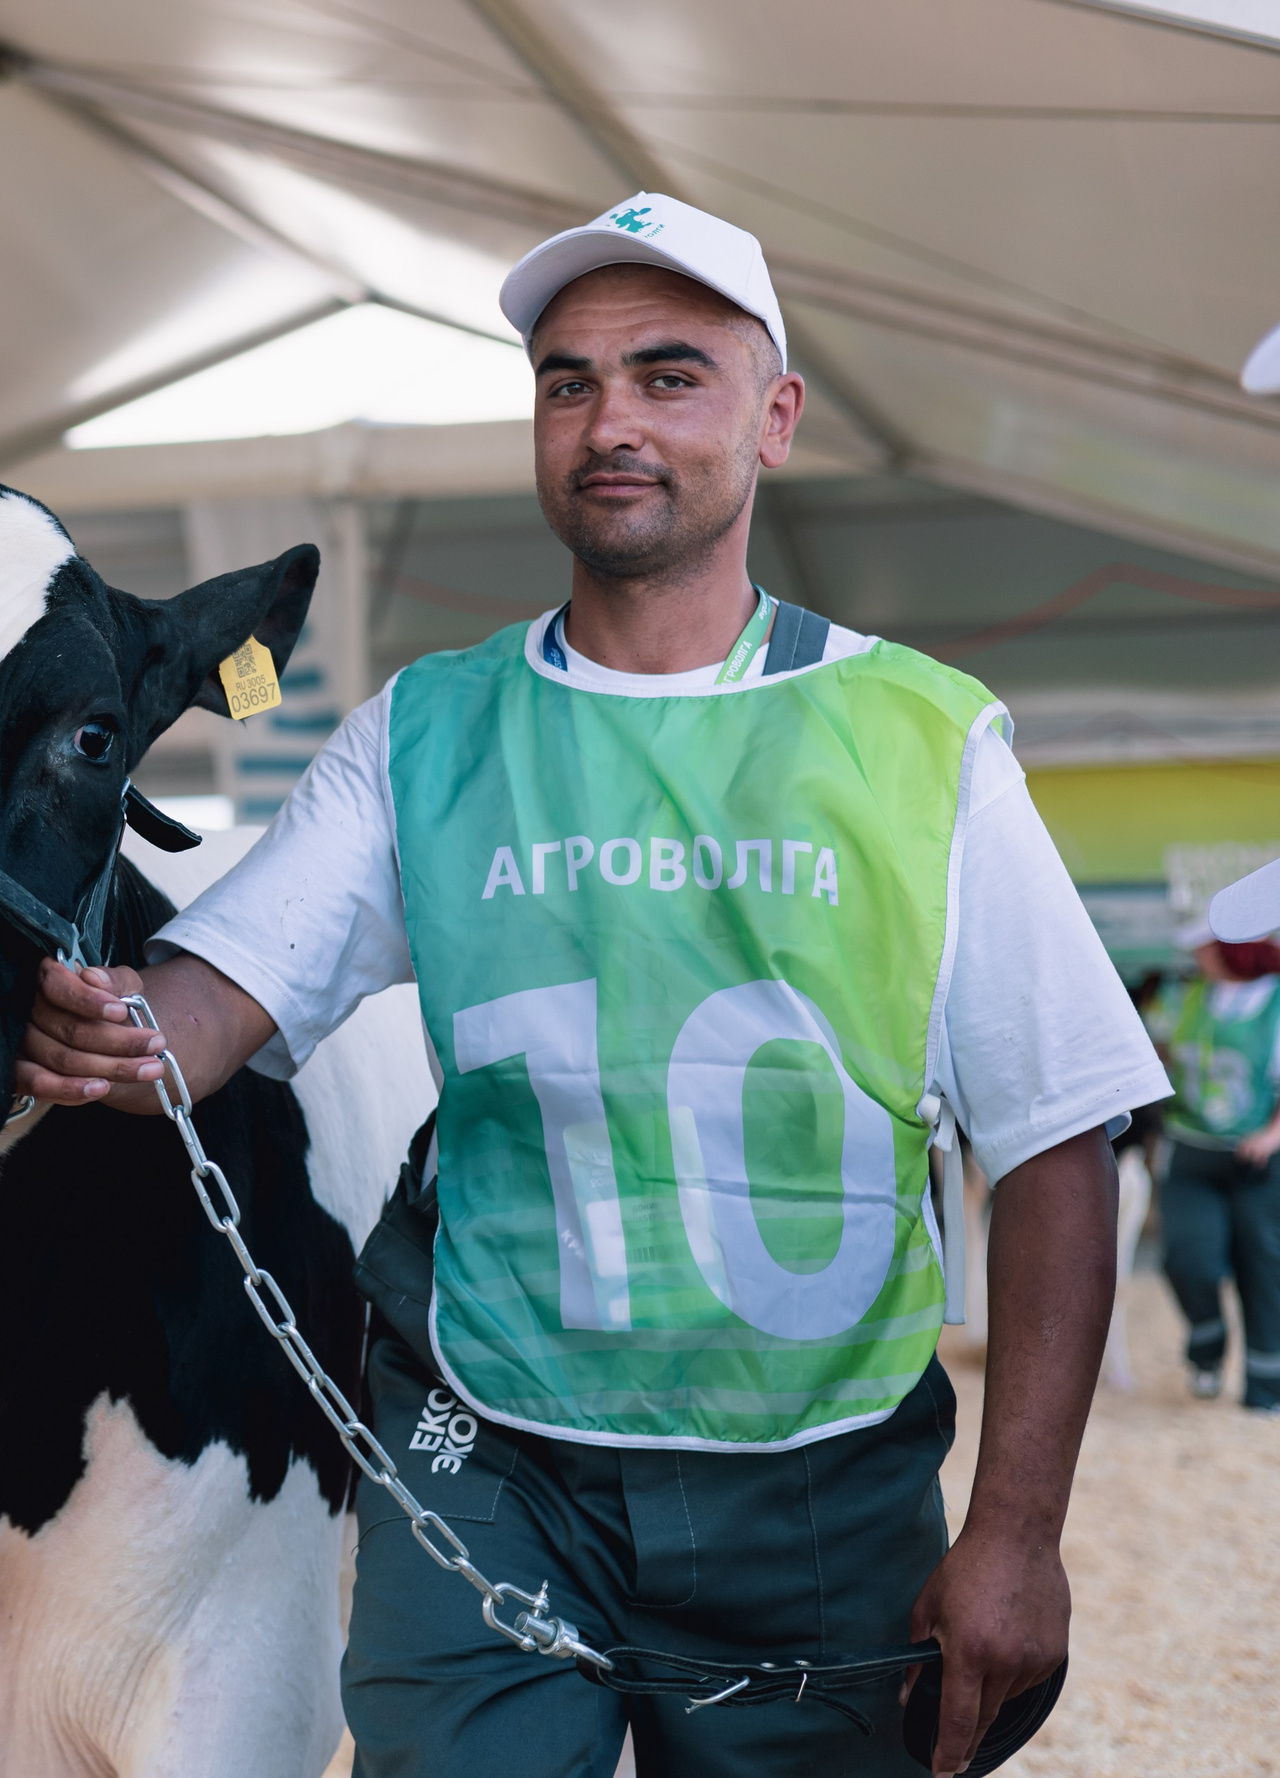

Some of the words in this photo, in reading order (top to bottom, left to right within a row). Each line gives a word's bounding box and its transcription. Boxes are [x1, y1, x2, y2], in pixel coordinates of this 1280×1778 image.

[235, 681, 246, 691] RU
[247, 674, 266, 688] 3005
[721, 640, 752, 684] ГРОВОЛГА
[231, 682, 276, 713] 03697
[482, 835, 839, 906] АГРОВОЛГА
[453, 976, 897, 1341] 10
[408, 1374, 458, 1451] EKO
